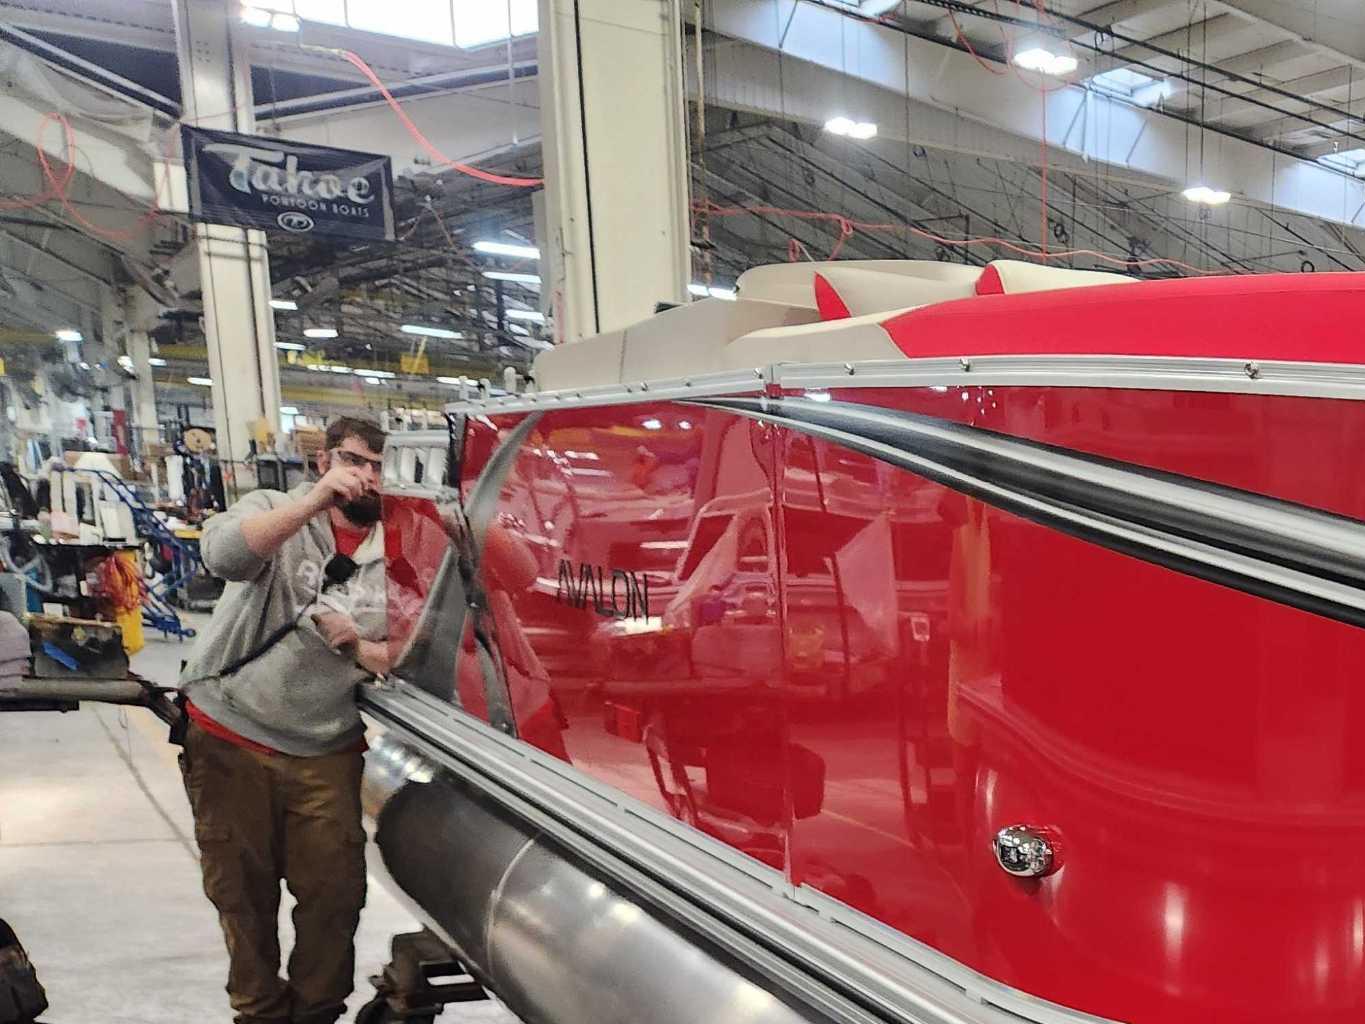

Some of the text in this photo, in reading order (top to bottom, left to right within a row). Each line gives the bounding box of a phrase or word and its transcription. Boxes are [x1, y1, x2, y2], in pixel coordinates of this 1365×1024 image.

[202, 143, 375, 203] Tahoe
[262, 194, 369, 217] PONTOON BOATS
[557, 559, 649, 624] AVALON
